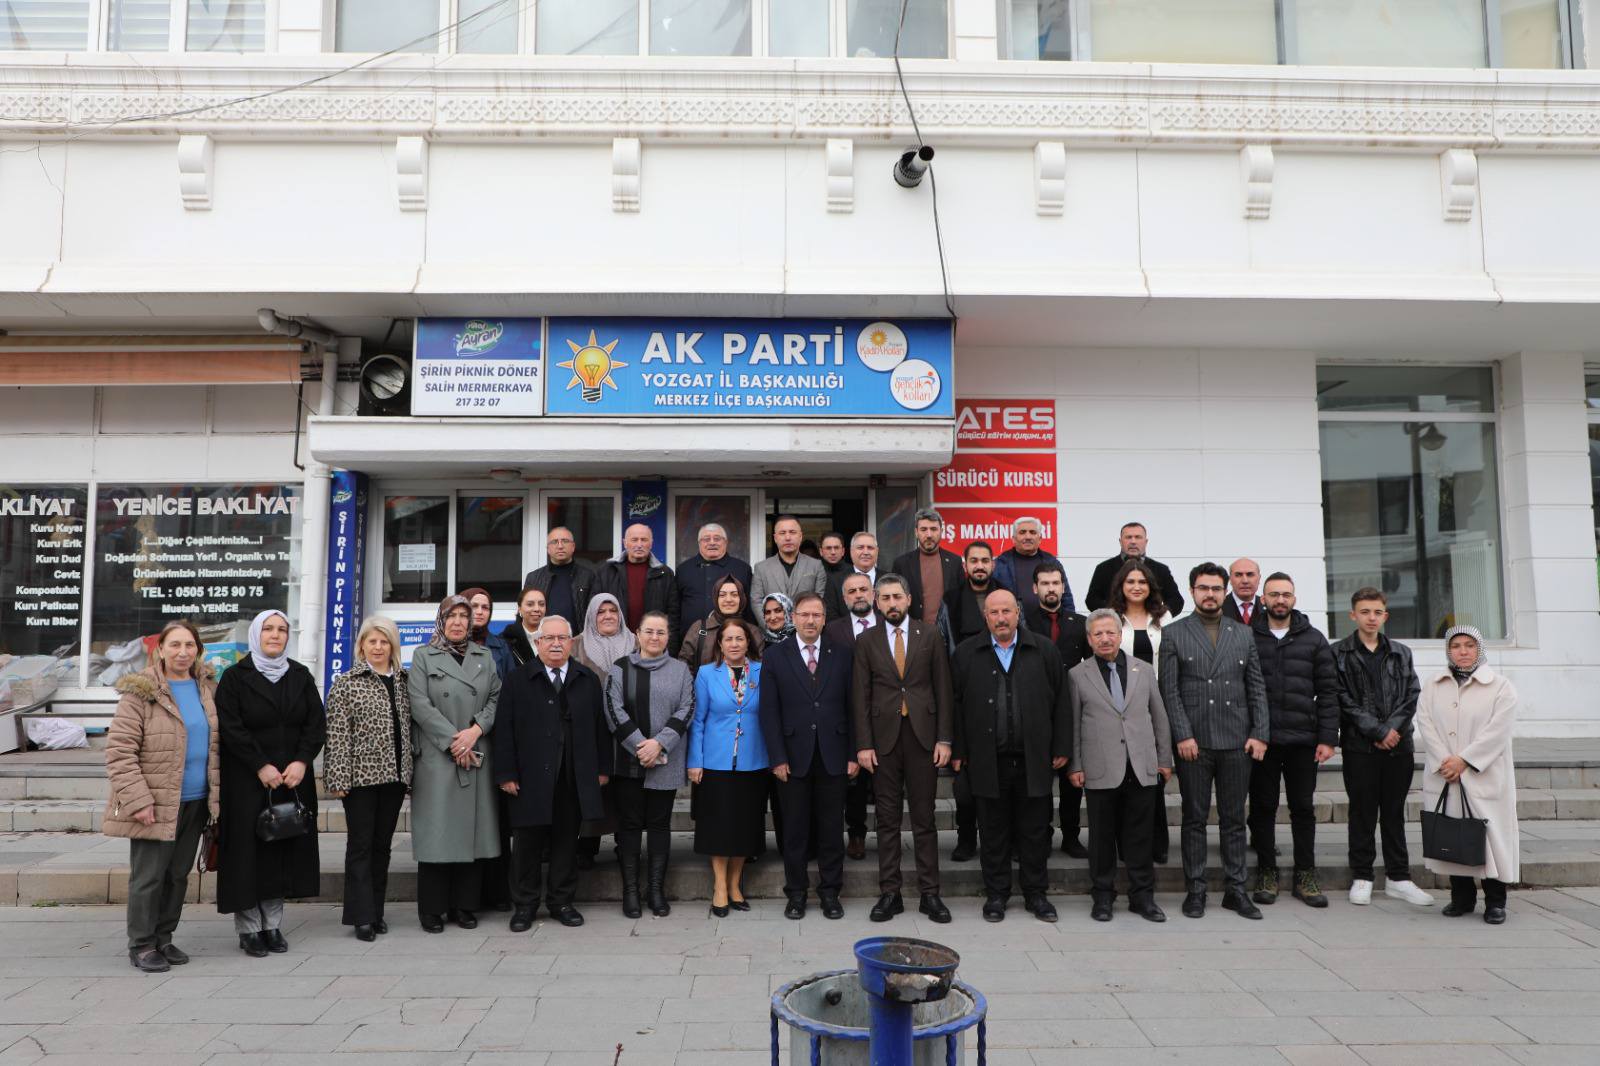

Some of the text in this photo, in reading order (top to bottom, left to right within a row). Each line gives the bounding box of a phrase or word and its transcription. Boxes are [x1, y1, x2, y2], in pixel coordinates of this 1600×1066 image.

[461, 329, 497, 348] Ayran
[641, 326, 844, 365] AK PARTİ
[420, 363, 538, 379] ŞİRİN PİKNİK DÖNER
[641, 369, 844, 391] YOZGAT İL BAŞKANLIĞI
[425, 380, 533, 393] SALİH MERMERKAYA
[455, 398, 501, 407] 217 32 07
[654, 392, 830, 409] MERKEZ İLÇE BAŞKANLIĞI
[937, 468, 1054, 487] SÜRÜCÜ KURSU
[112, 493, 300, 516] YENİCE BAKLİYAT
[30, 523, 54, 533] Kuru
[37, 539, 82, 548] Kuru Erik
[335, 511, 348, 574] ŞİRİN
[35, 554, 59, 564] Kuru
[104, 552, 147, 564] Doğadan
[150, 552, 194, 562] Sofranıza
[196, 552, 218, 562] Yerli
[225, 552, 263, 563] Organik
[54, 570, 81, 579] Ceviz
[133, 567, 272, 580] Ürünlerimizle Hizmetinizdeyiz
[16, 585, 80, 597] Kompostuluk
[140, 587, 166, 598] TEL
[175, 586, 205, 598] 0505
[207, 586, 229, 597] 125
[230, 586, 246, 597] 90
[248, 586, 264, 597] 75
[14, 601, 79, 610] Kuru Patlıcan
[161, 602, 239, 613] Mustafa YENİCE
[26, 617, 79, 626] Kuru Biber
[332, 578, 345, 654] PİKNİK
